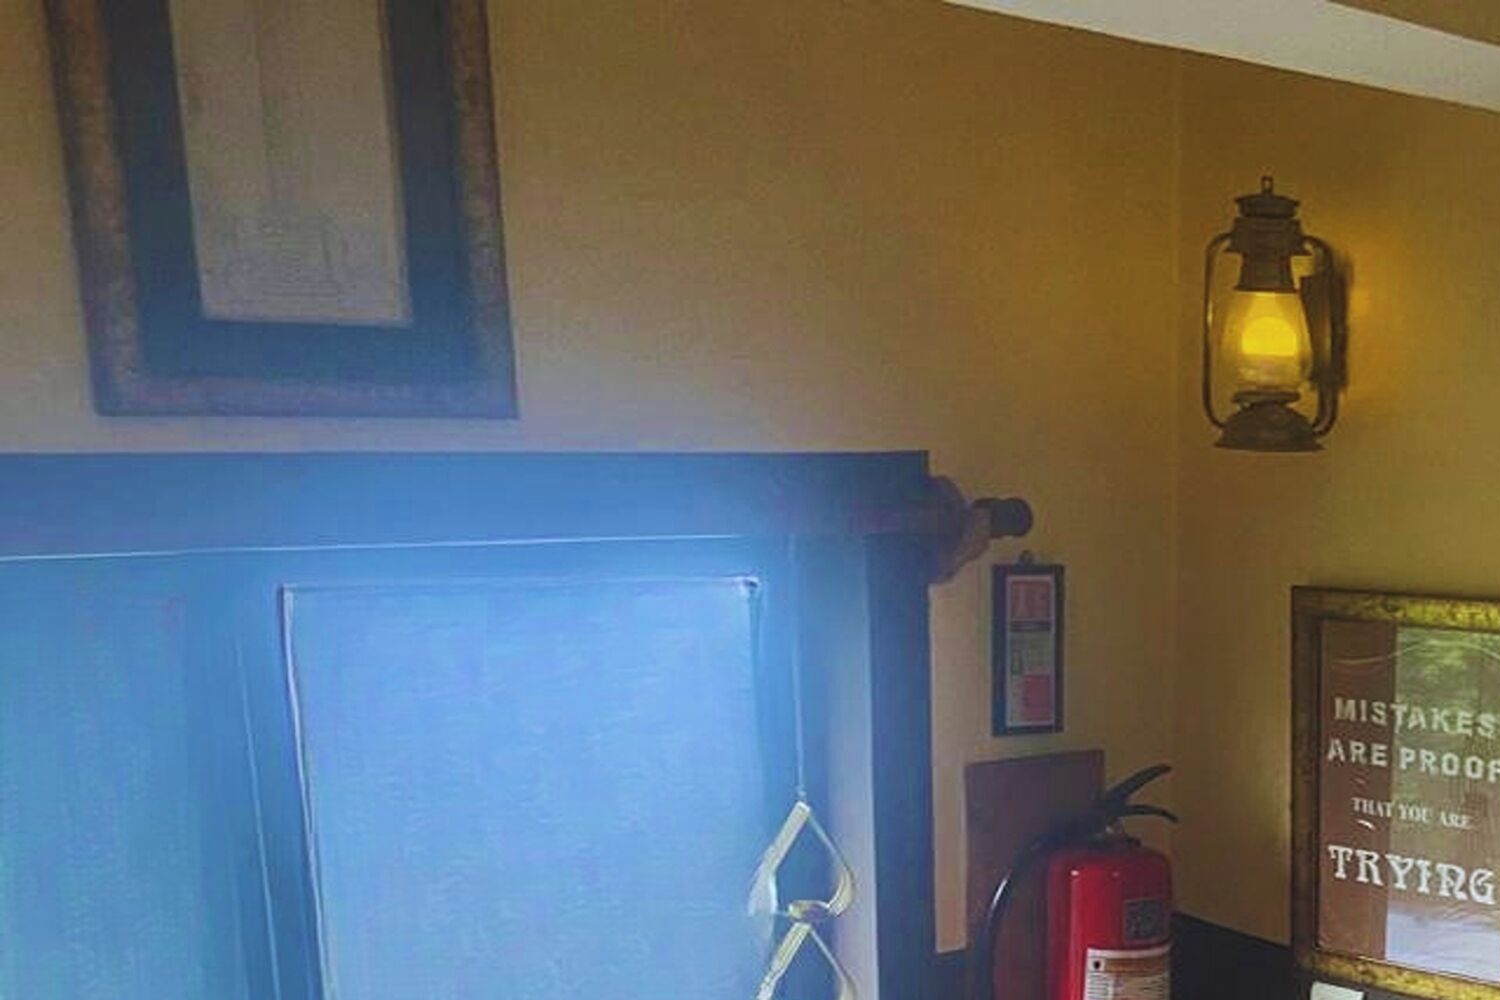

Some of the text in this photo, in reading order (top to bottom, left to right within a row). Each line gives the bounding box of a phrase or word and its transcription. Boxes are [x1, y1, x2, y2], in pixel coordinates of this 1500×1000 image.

[1334, 698, 1496, 738] MISTAKES
[1327, 739, 1388, 767] ARE
[1351, 797, 1473, 831] THAT YOU ARE
[1328, 845, 1496, 905] TRYING
